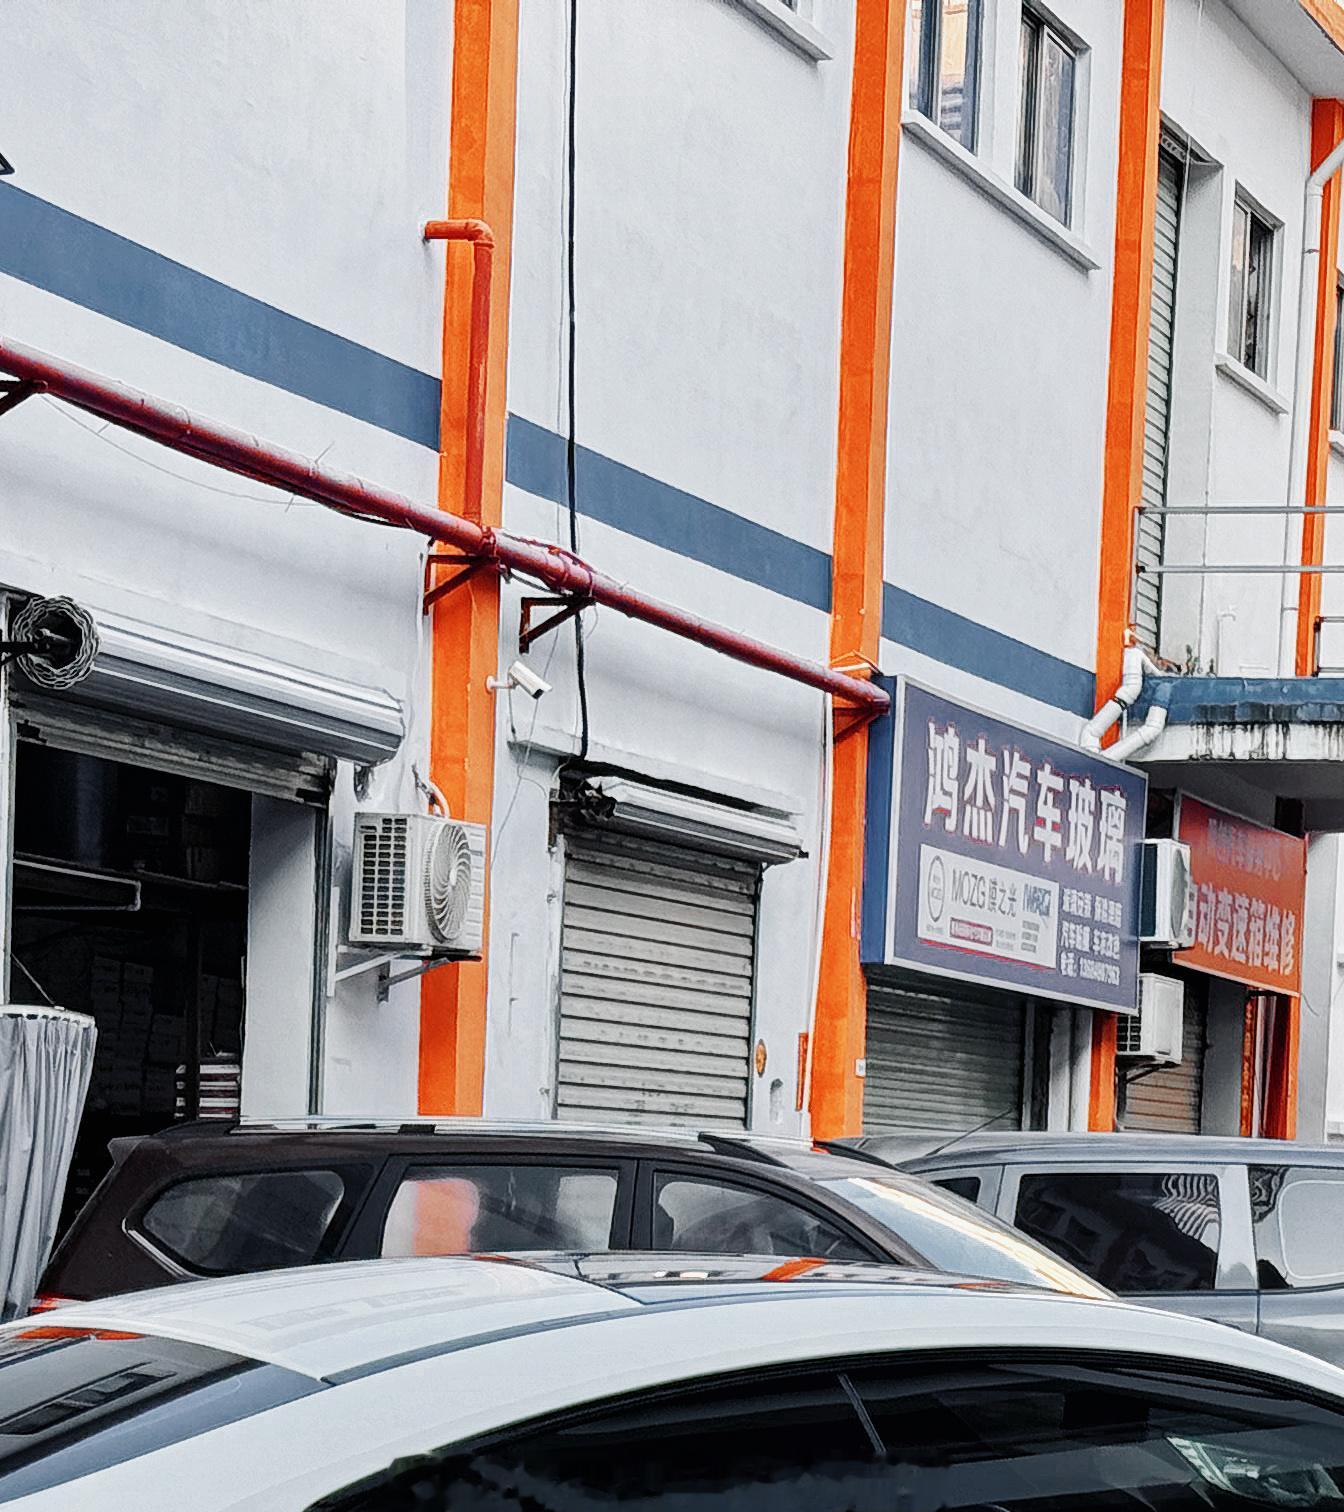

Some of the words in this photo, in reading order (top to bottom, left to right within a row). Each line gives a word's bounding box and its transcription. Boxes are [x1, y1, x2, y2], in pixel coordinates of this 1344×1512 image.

[923, 716, 1127, 884] 鸿杰汽车玻璃
[951, 867, 987, 910] MOZG
